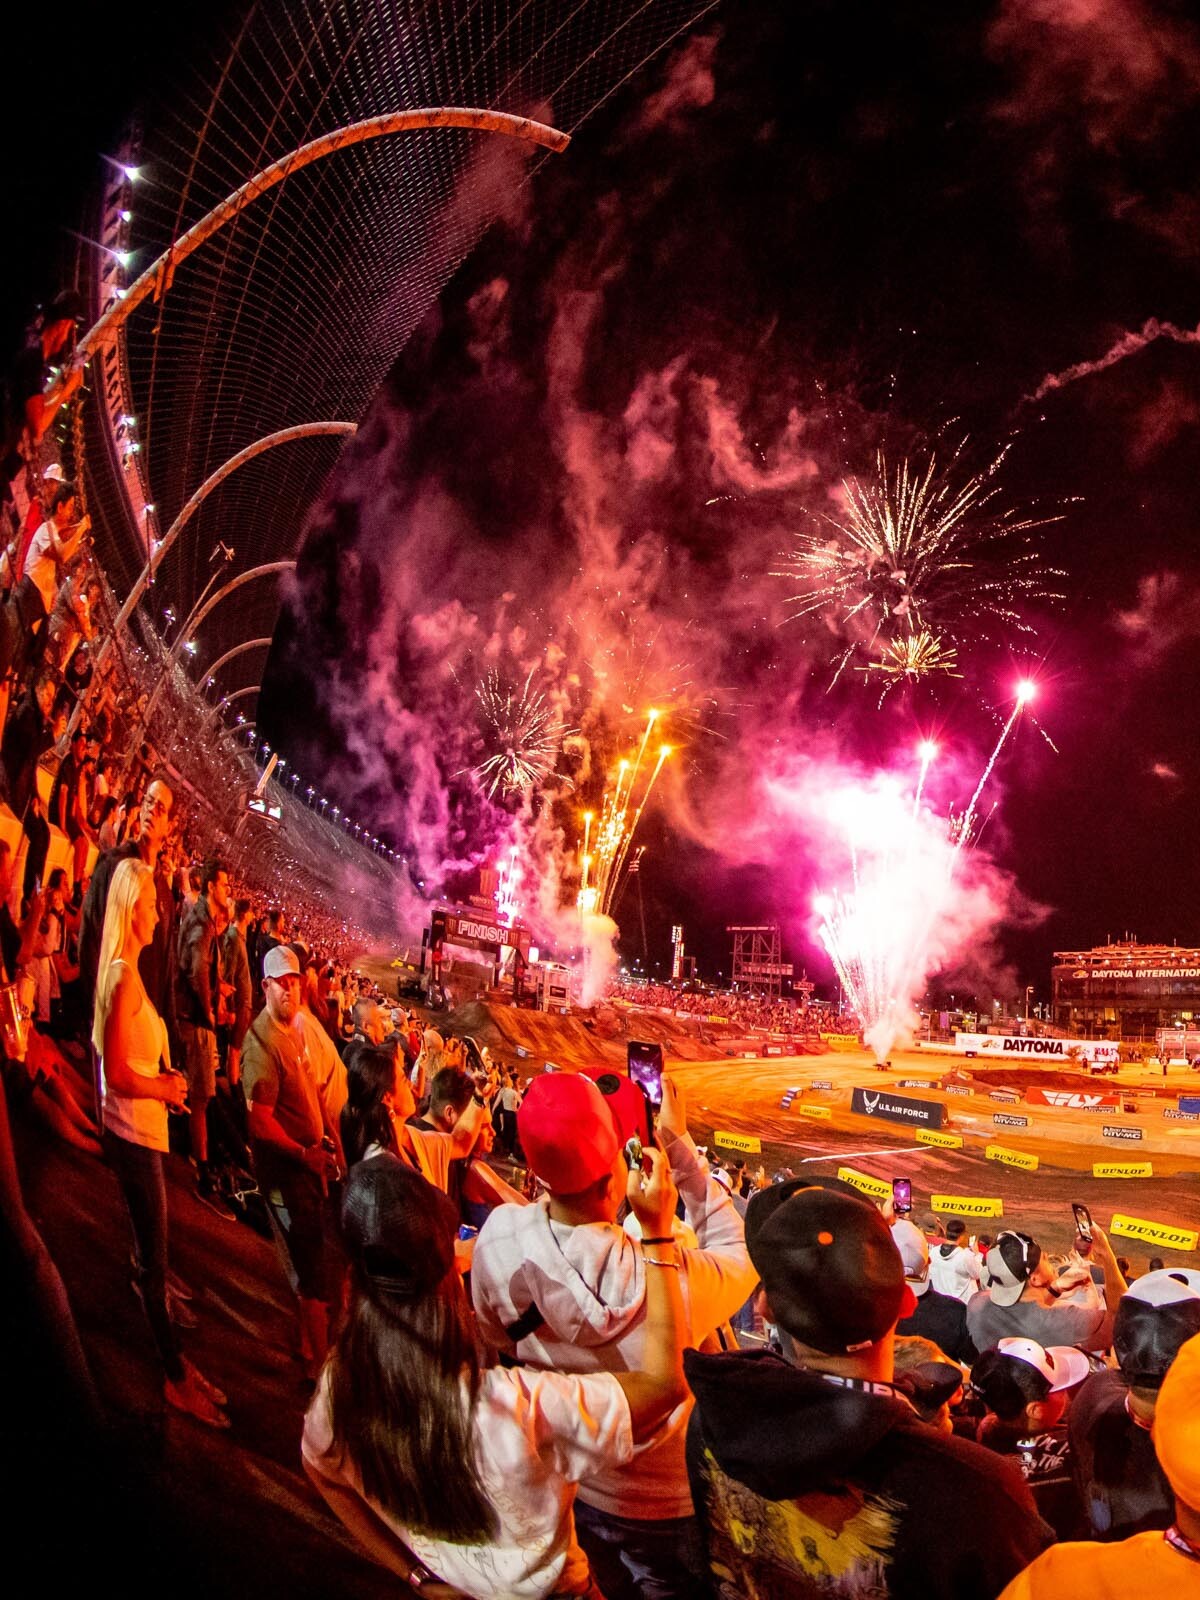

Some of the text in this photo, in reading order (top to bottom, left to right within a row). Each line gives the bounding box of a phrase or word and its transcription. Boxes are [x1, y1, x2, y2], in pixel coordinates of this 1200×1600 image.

[458, 920, 509, 944] FINISH
[1092, 969, 1133, 979] DAYTONA
[1003, 1039, 1063, 1055] DAYTONA
[1041, 1090, 1103, 1108] FLY
[879, 1103, 929, 1119] U.S. AIR FORCE
[720, 1137, 750, 1150] DUNLOP
[922, 1134, 955, 1146] DUNLOP
[993, 1153, 1031, 1166] DUNLOP
[1102, 1166, 1145, 1175] DUNLOP
[846, 1176, 889, 1195] DUNLOP
[941, 1201, 991, 1212] DUNLOP
[1126, 1223, 1192, 1244] DUNLOP
